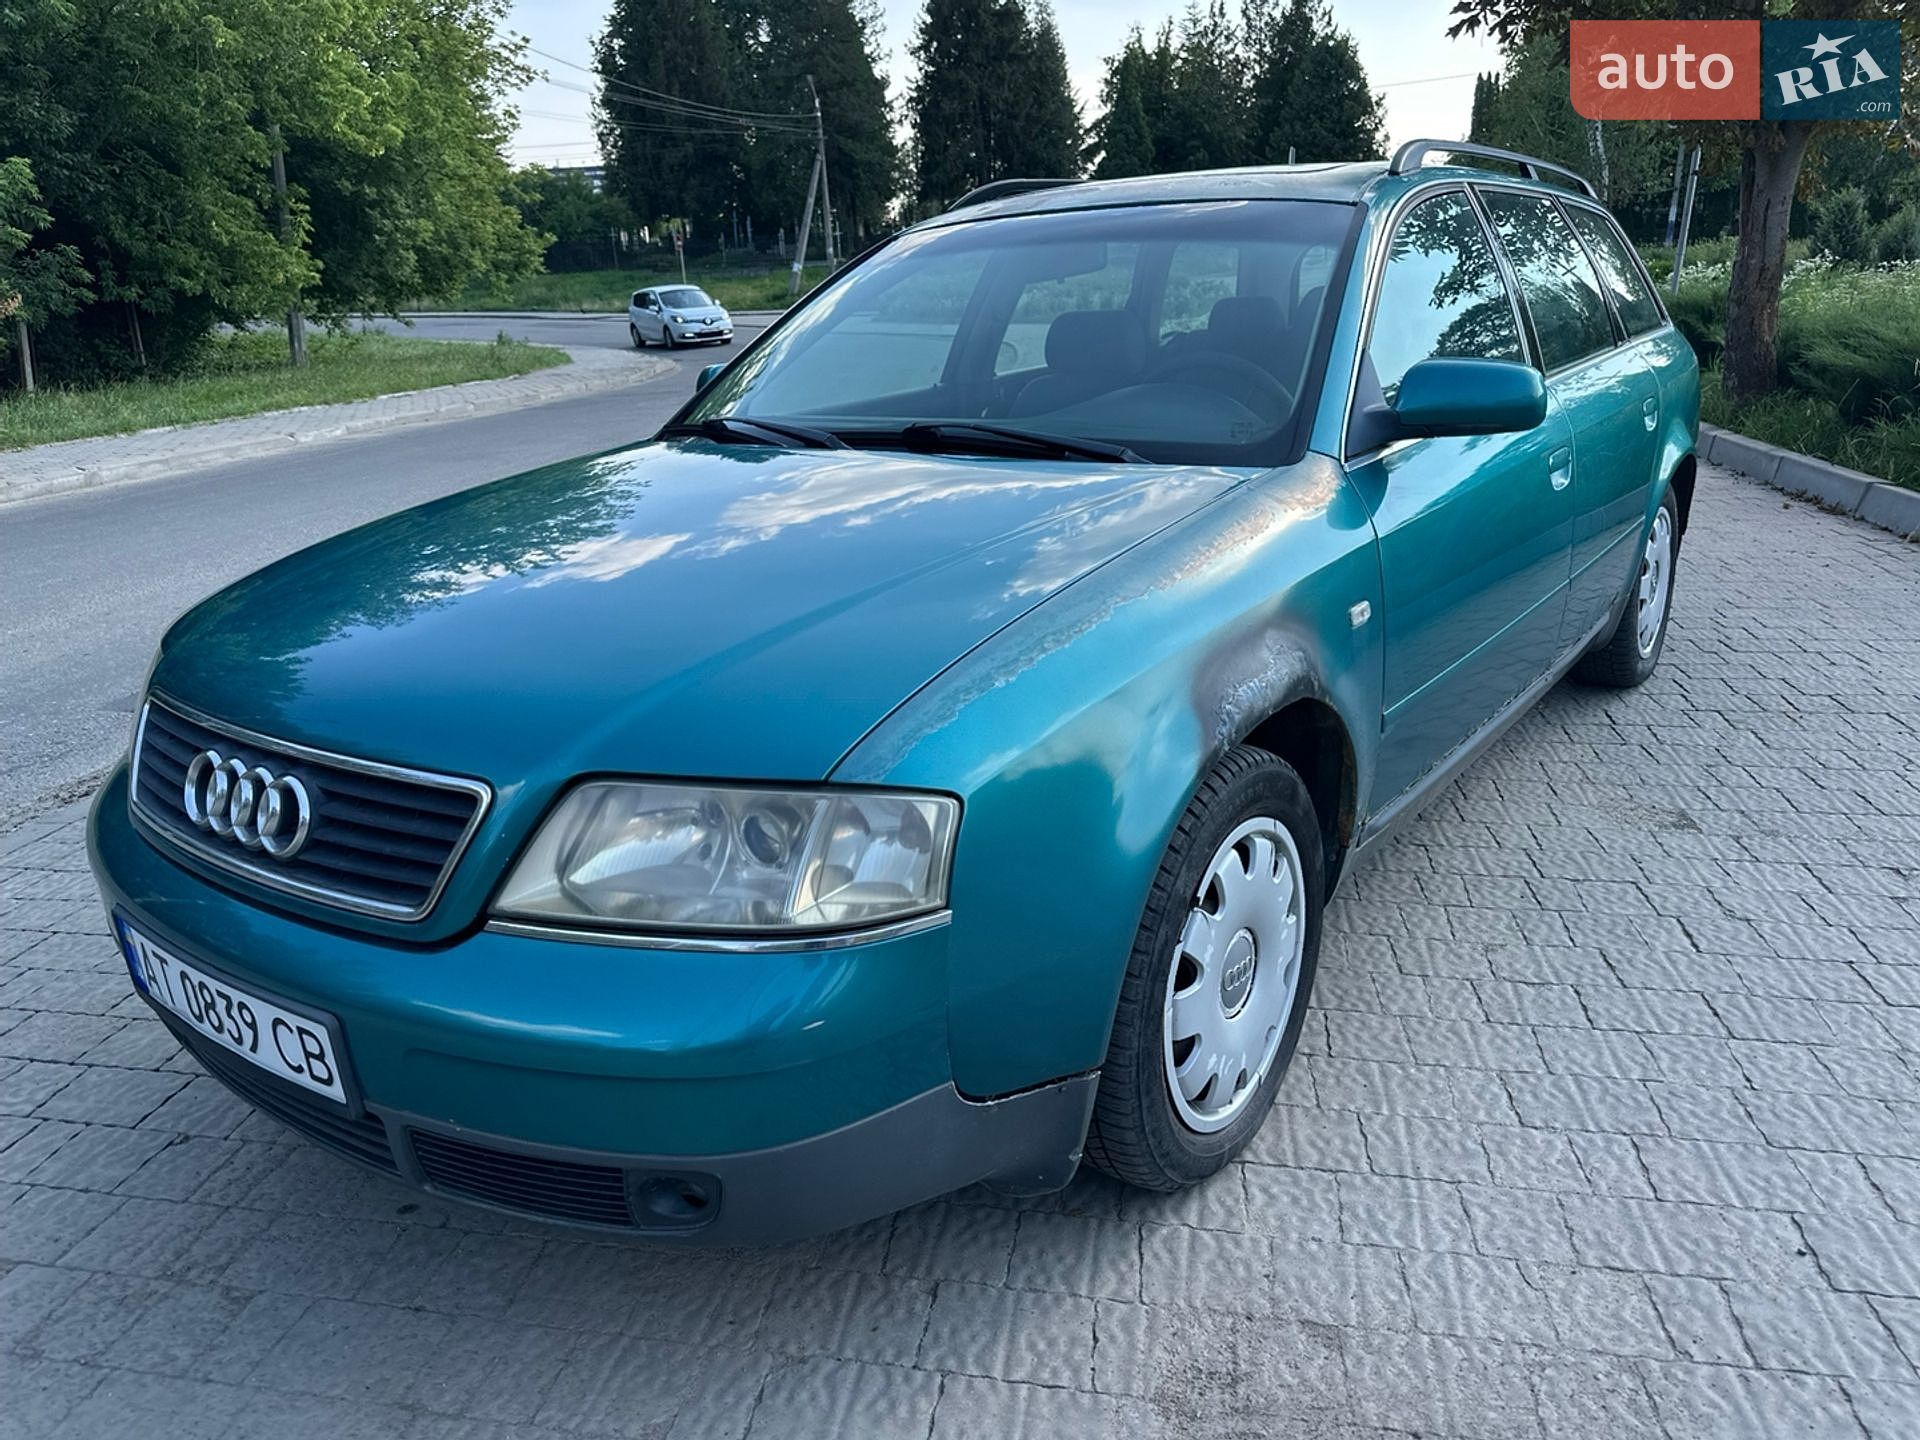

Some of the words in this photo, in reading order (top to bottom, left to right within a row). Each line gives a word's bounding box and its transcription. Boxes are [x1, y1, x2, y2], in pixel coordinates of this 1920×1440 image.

[140, 942, 176, 1006] AT
[180, 970, 259, 1054] 0839
[272, 1018, 334, 1087] CB
